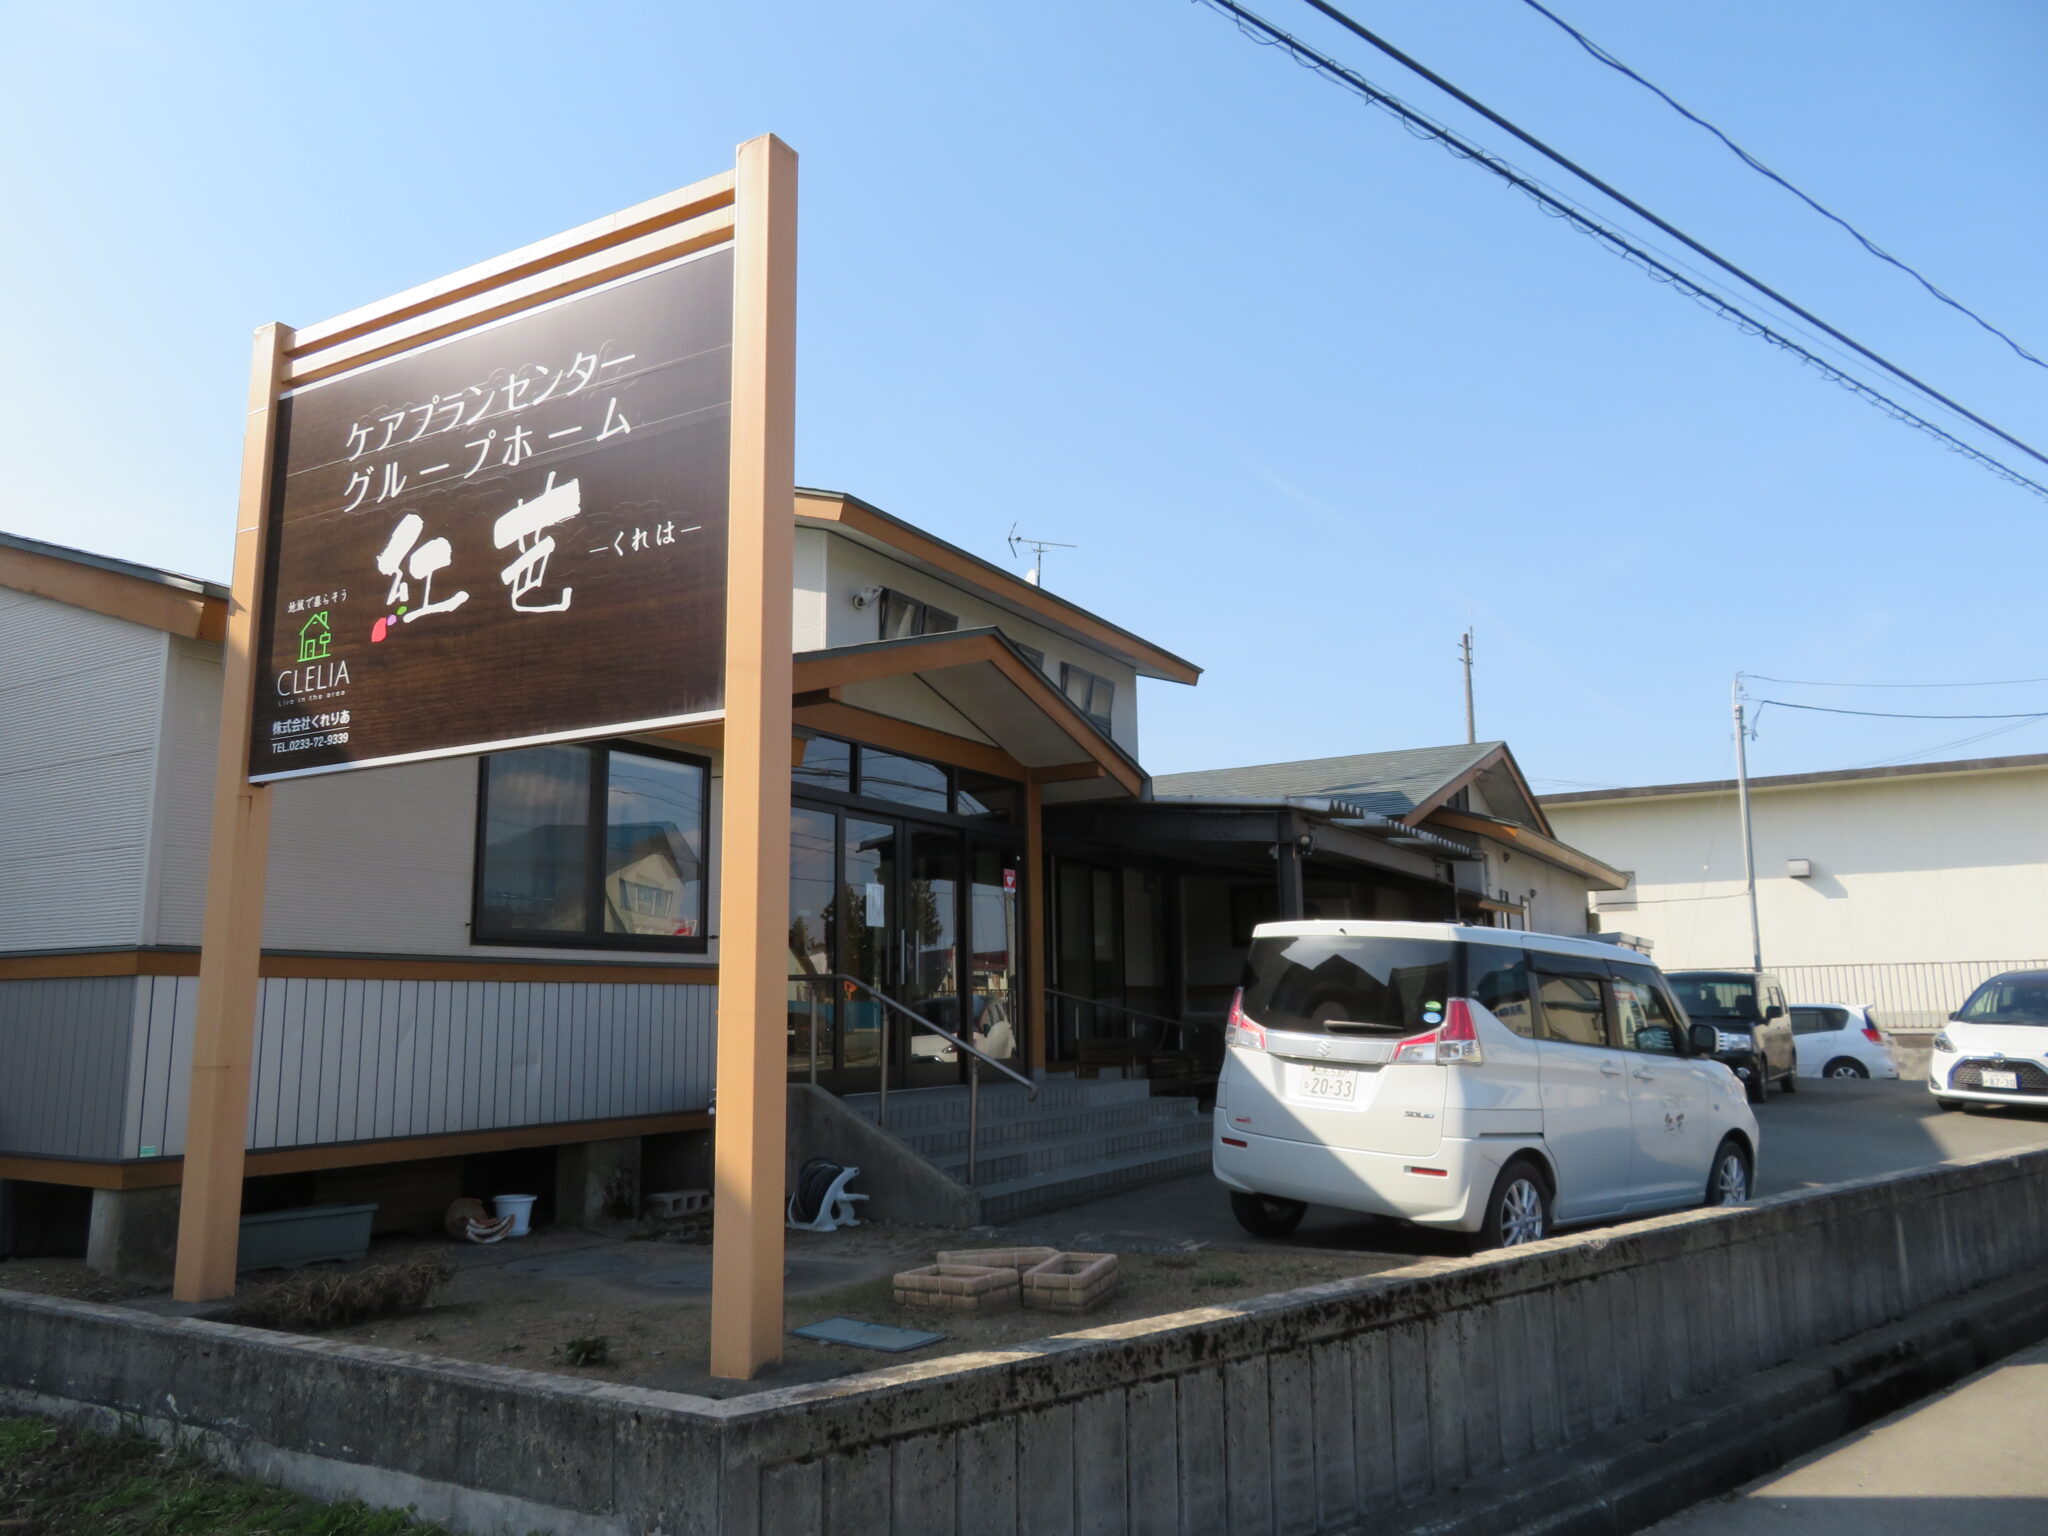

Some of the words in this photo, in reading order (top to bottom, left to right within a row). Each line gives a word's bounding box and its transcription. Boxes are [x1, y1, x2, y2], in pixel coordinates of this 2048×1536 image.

[346, 352, 636, 461] ケアプランセンター
[344, 397, 631, 513] グループホーム
[277, 660, 350, 697] CLELIA
[272, 709, 350, 735] 株式会社くれりあ
